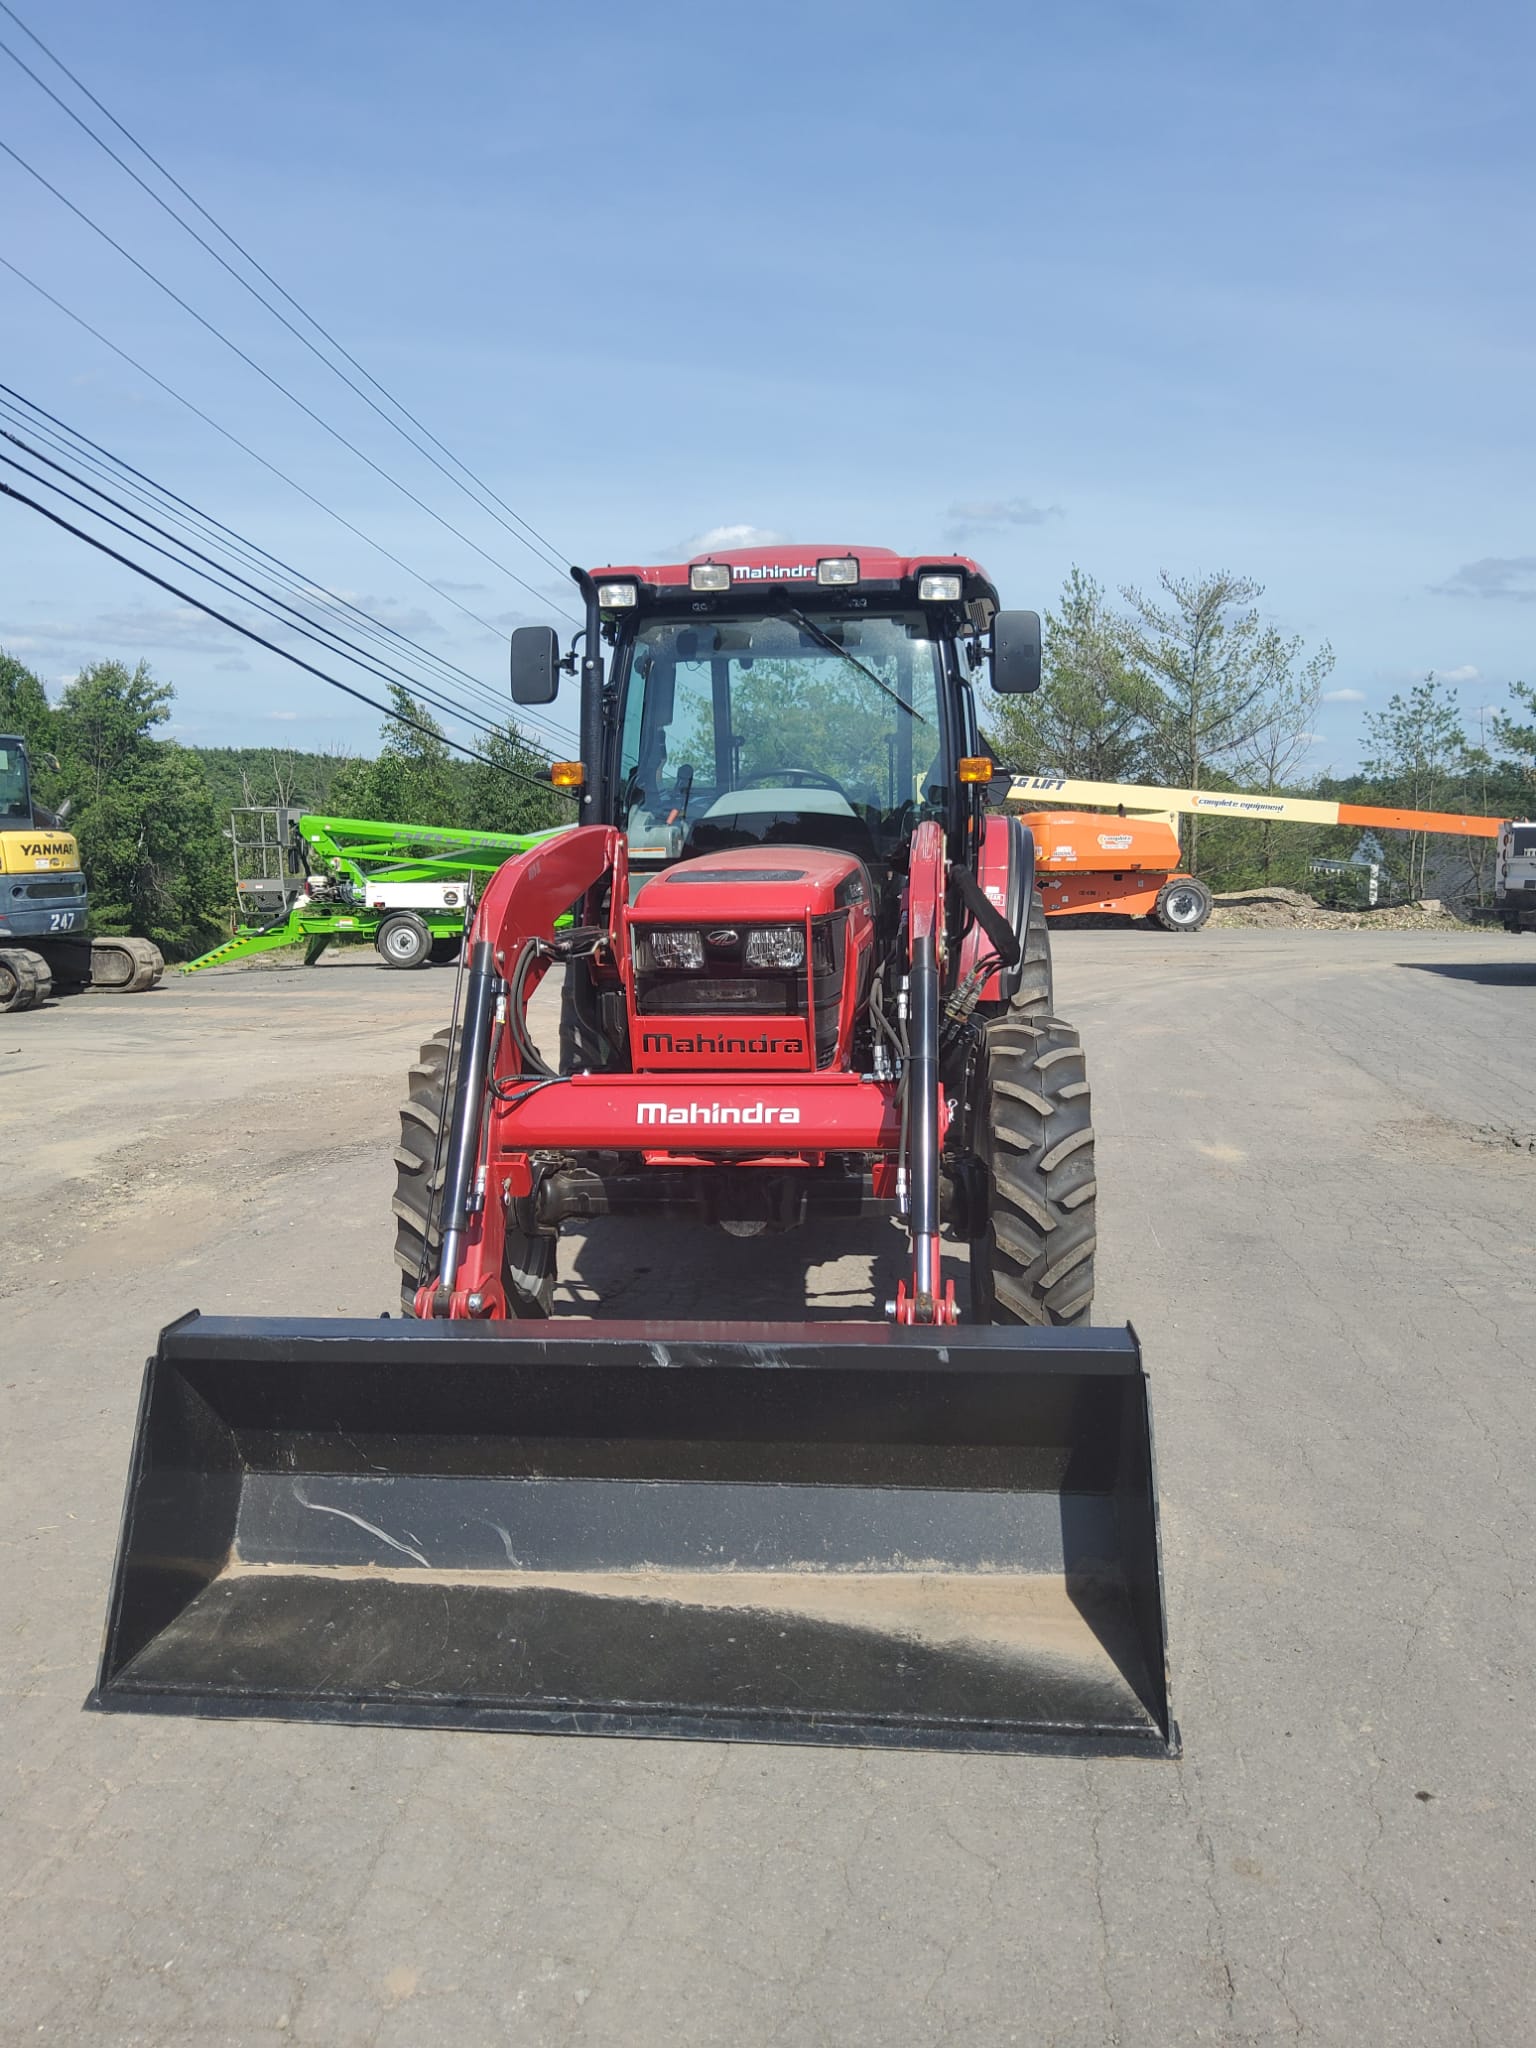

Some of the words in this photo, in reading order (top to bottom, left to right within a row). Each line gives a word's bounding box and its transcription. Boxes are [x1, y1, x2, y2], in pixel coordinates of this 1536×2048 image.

[1031, 778, 1066, 791] LIFT
[1198, 798, 1239, 809] complete
[1239, 802, 1285, 814] equipment
[50, 912, 75, 931] 247
[642, 1033, 803, 1053] Mahindra
[636, 1102, 801, 1124] Mahindra
